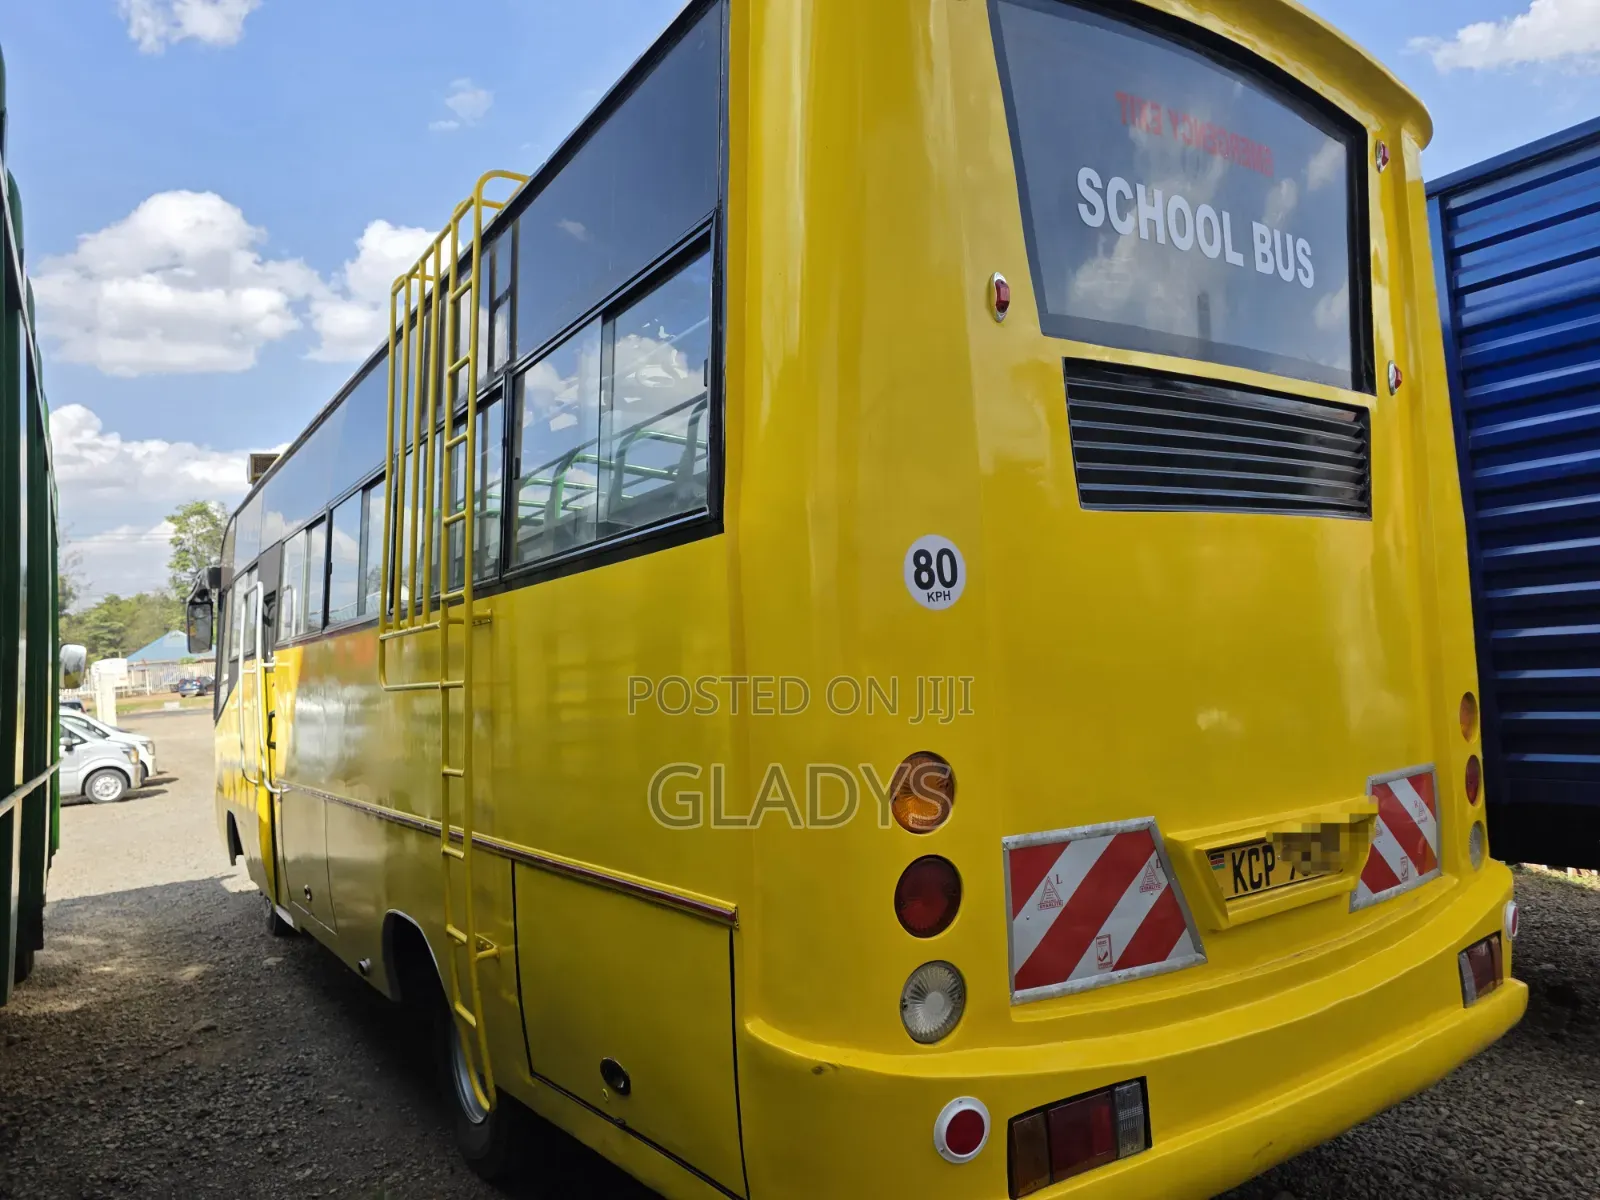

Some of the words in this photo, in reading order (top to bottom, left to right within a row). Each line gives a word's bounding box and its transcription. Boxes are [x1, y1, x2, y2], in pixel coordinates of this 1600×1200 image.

[1077, 166, 1244, 267] SCHOOL
[1252, 220, 1315, 289] BUS
[912, 547, 958, 591] 80
[926, 590, 951, 603] KPH
[1055, 873, 1063, 885] L
[1231, 844, 1276, 894] KCP
